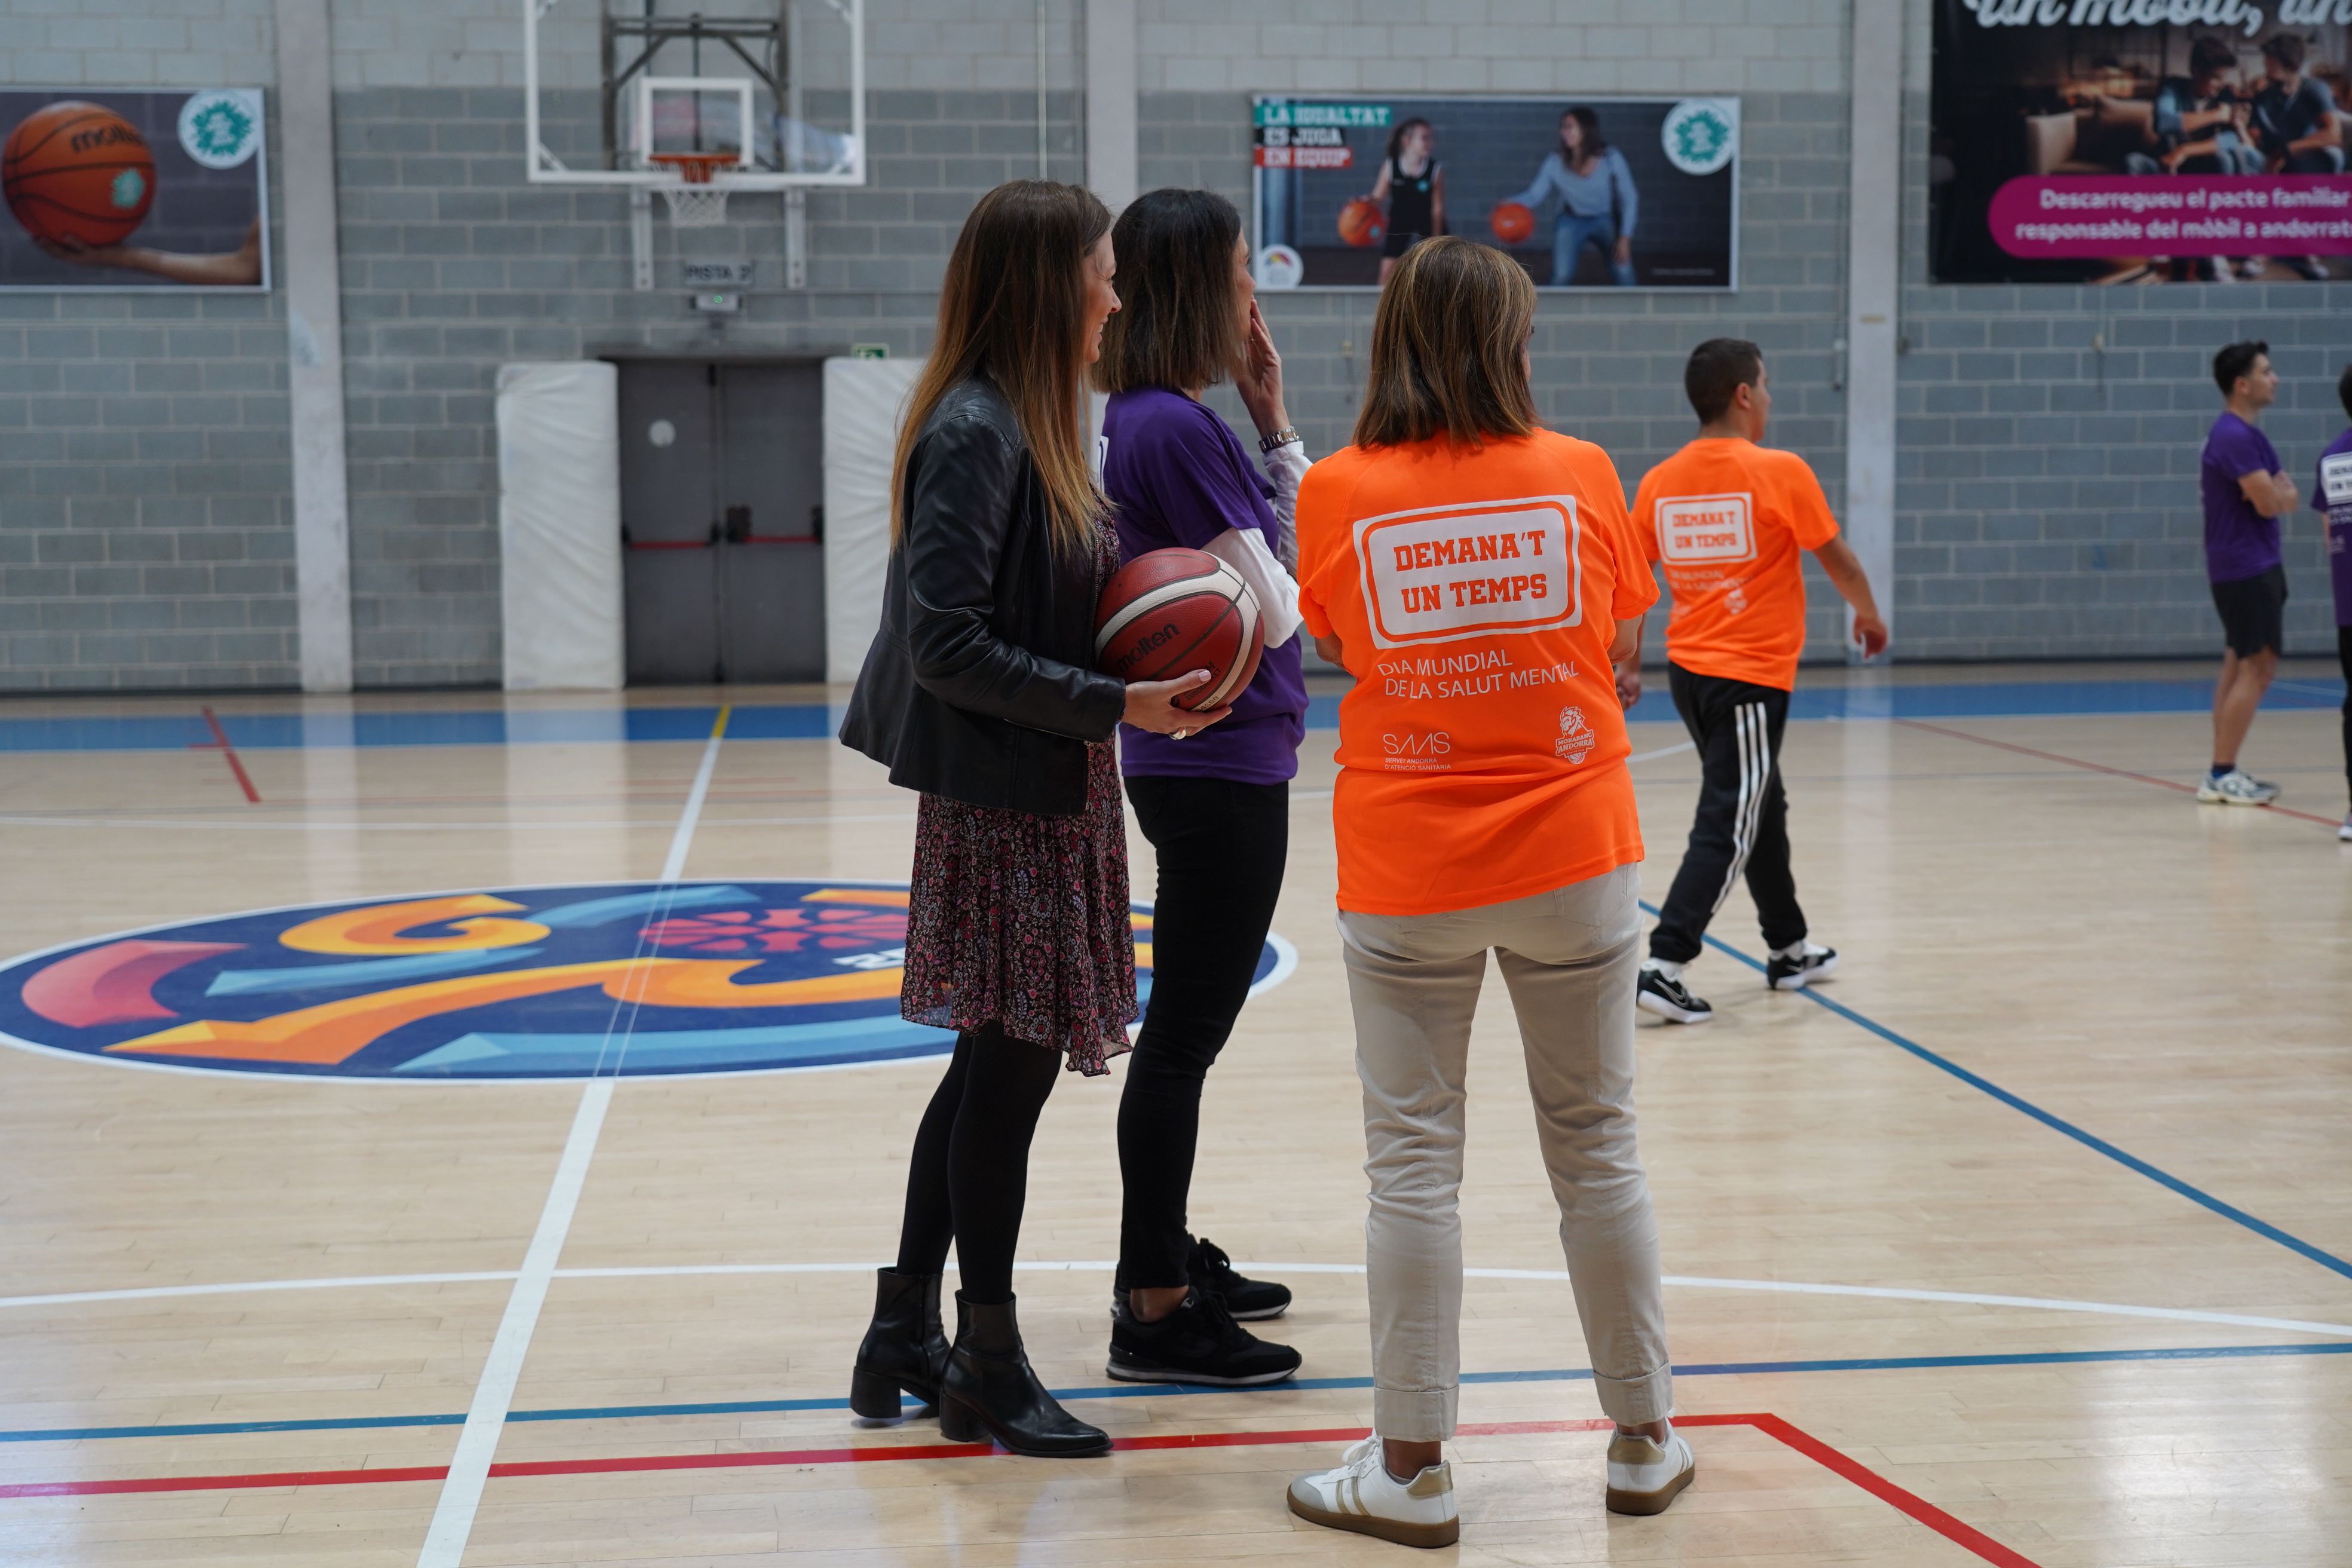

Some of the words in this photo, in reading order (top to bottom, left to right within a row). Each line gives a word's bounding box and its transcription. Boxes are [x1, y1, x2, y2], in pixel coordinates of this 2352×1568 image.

[1263, 106, 1291, 125] LA
[1293, 105, 1389, 125] IGUALTAT
[1263, 127, 1291, 146] ES
[1290, 127, 1344, 146] JUGA
[1263, 149, 1291, 167] EN
[1293, 148, 1351, 168] EQUIP
[2040, 188, 2183, 213] Descarregueu
[2186, 187, 2207, 207] el
[2209, 189, 2269, 212] pacte
[2272, 186, 2351, 208] familiar
[2015, 218, 2143, 244] responsable
[2145, 218, 2179, 239] del
[2244, 221, 2257, 238] a
[1394, 530, 1545, 571] DEMANA'T
[1674, 535, 1693, 549] UN
[1695, 532, 1737, 548] TEMPS
[1401, 584, 1441, 613] UN
[1449, 574, 1547, 607] TEMPS
[1116, 623, 1180, 673] molten
[1377, 659, 1414, 676] DIA
[1417, 649, 1513, 676] MUNDIAL
[1386, 678, 1407, 697] DE
[1410, 681, 1432, 699] LA
[1438, 673, 1503, 698] SALUT
[1510, 661, 1579, 688] MENTAL
[1557, 732, 1592, 746] MORABANC
[1557, 739, 1593, 754] ANDORRA
